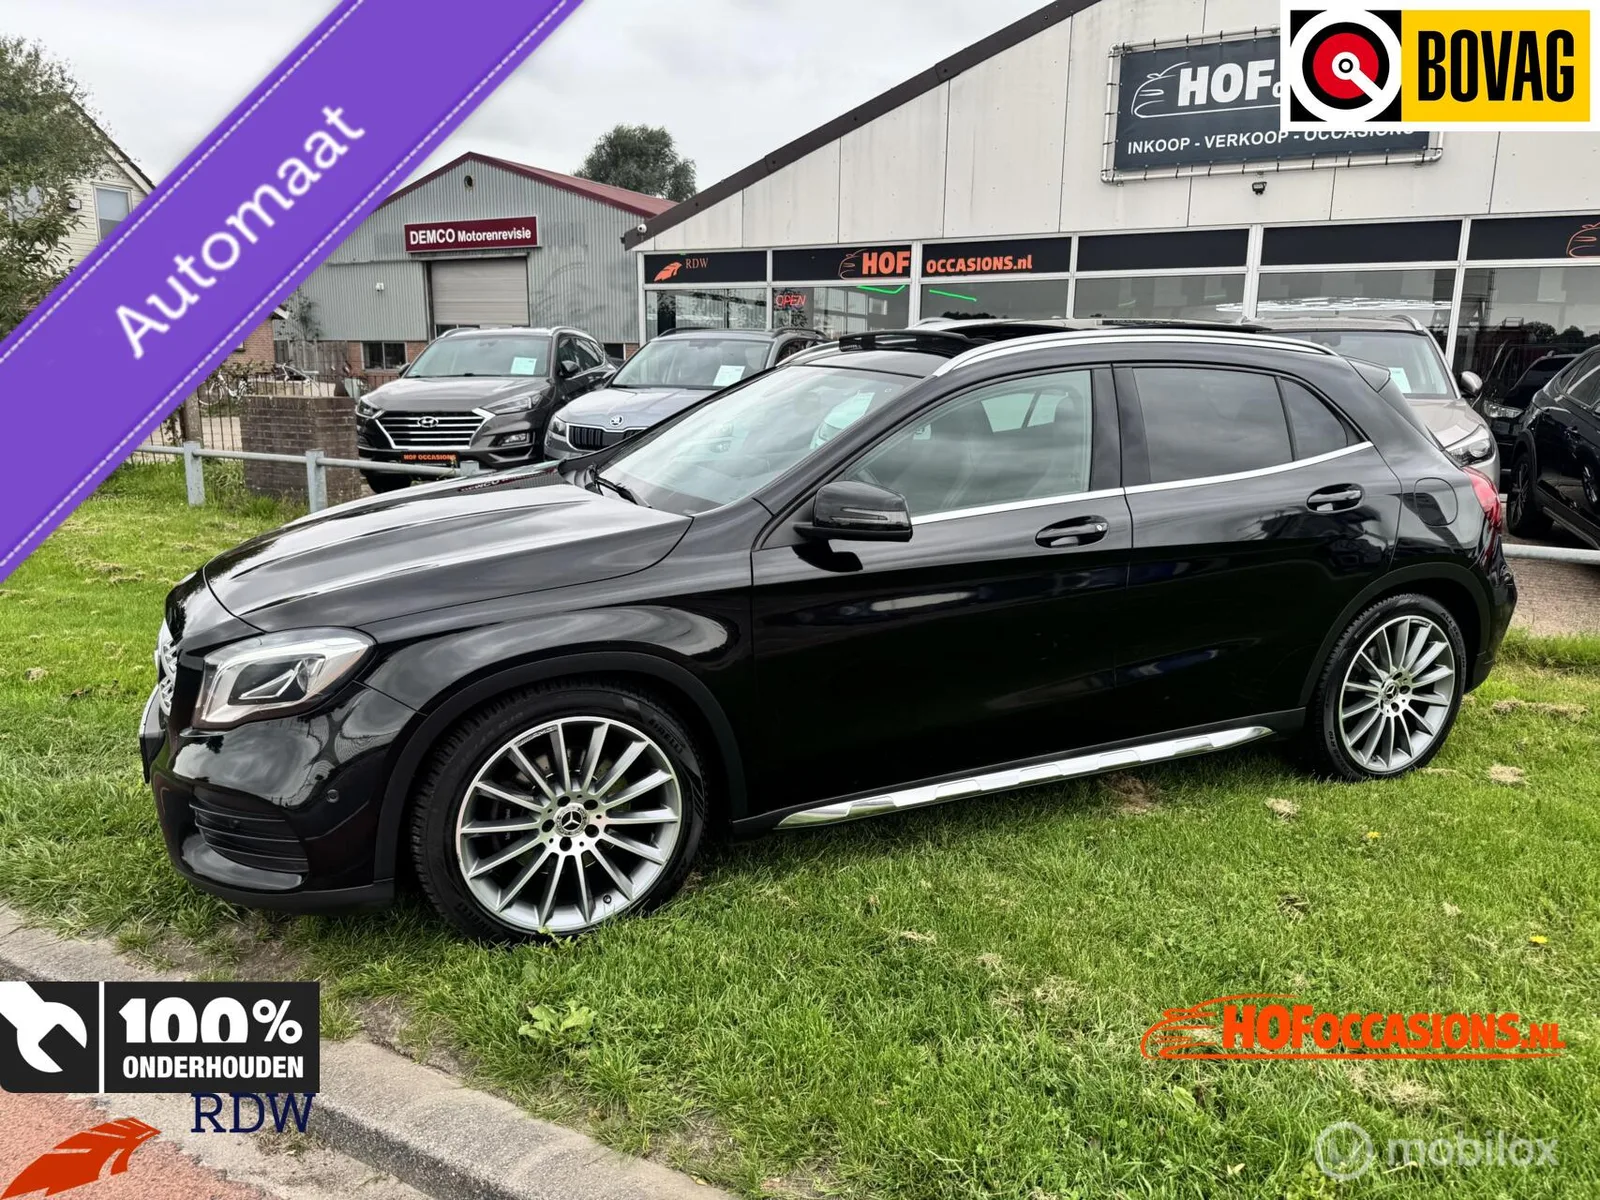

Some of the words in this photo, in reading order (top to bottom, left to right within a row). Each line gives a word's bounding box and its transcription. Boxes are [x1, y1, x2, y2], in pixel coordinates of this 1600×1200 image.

[1127, 136, 1190, 155] INKOOP
[1204, 130, 1289, 150] VERKOOP
[1303, 130, 1414, 142] OCCASI
[409, 228, 456, 245] DEMCO
[457, 227, 532, 243] Motorenrevisie
[685, 258, 709, 269] RDW
[861, 250, 911, 275] HOF
[926, 254, 1033, 274] OCCASIONS.nl
[775, 294, 806, 308] OPEN
